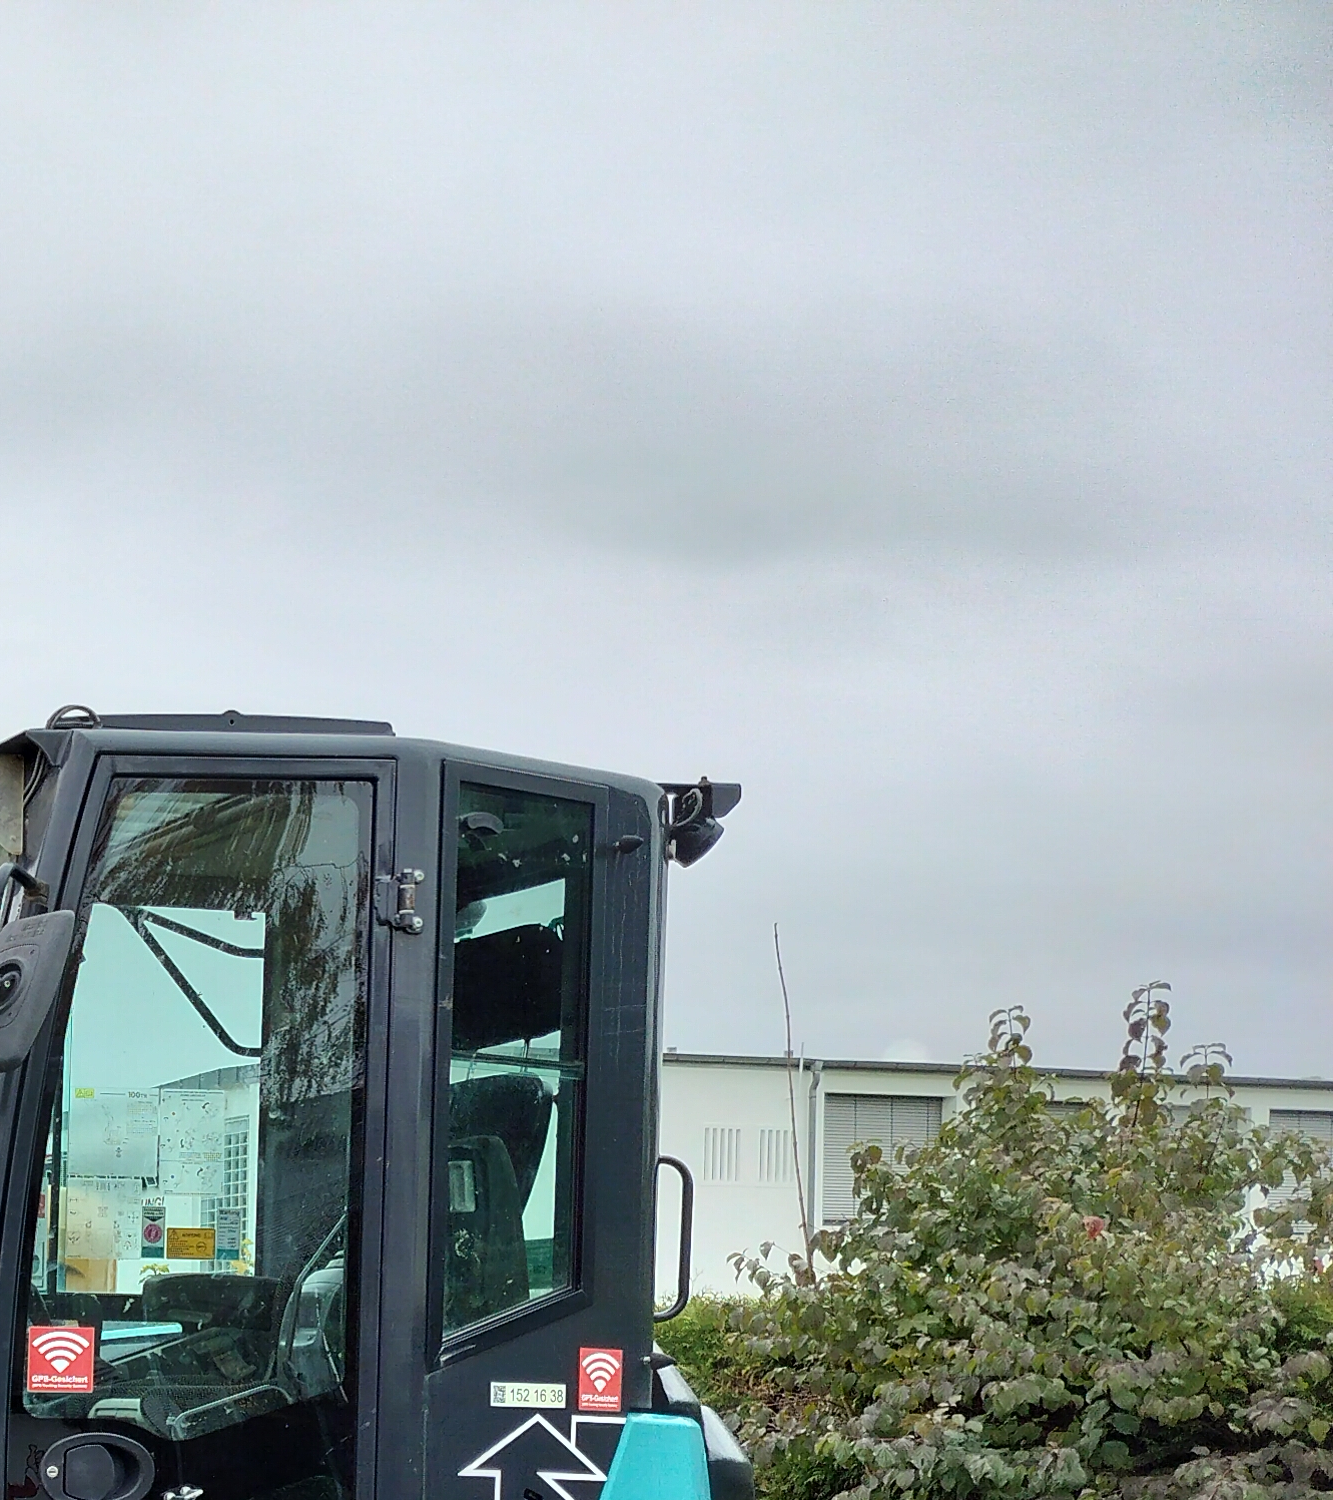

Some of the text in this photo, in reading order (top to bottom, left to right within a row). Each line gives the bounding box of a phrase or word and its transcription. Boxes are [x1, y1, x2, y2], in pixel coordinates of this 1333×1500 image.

[509, 1388, 564, 1403] 152 16 38
